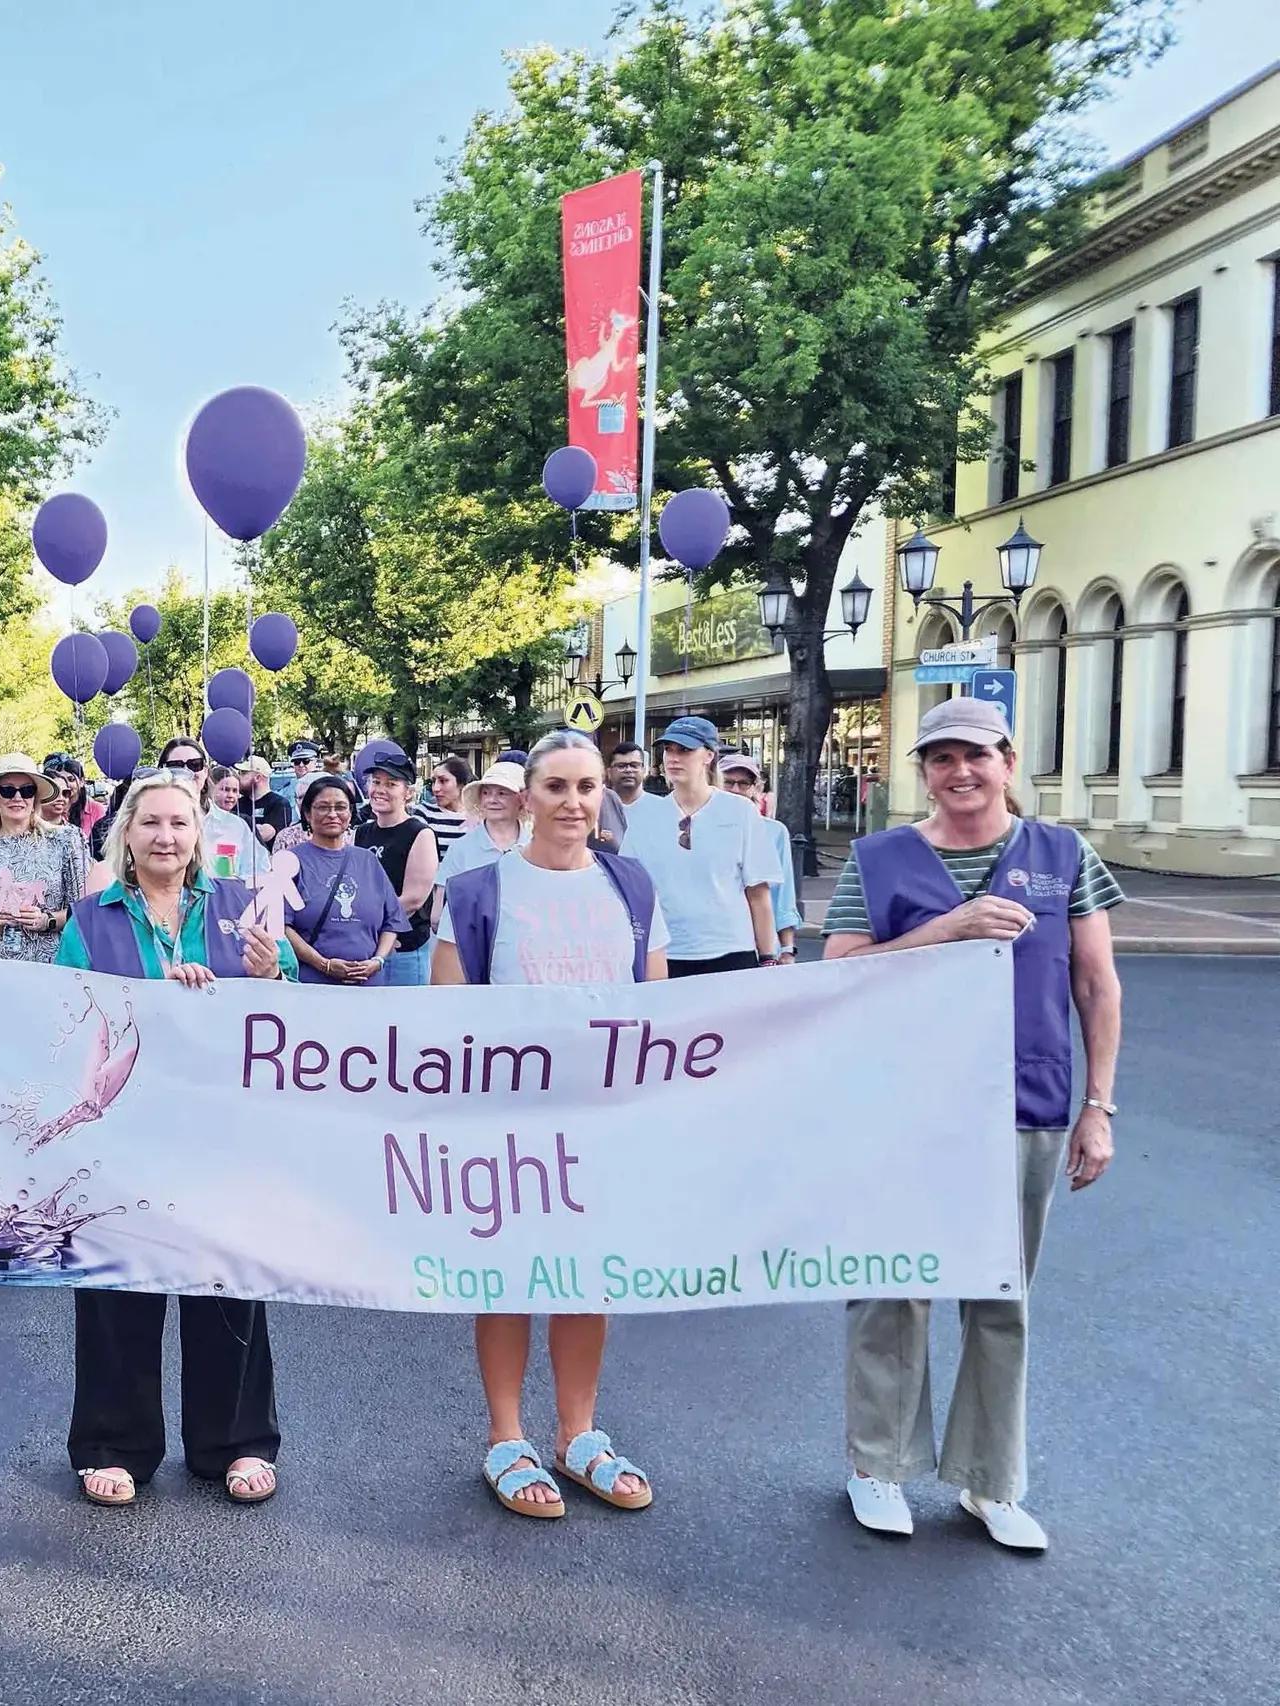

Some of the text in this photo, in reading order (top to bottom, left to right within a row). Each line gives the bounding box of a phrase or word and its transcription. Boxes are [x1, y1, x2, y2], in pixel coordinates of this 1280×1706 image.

[923, 651, 956, 663] CHURCH
[242, 1012, 725, 1095] Reclaim The
[383, 1132, 585, 1239] Night
[413, 1245, 940, 1311] Stop All Sexual Violence
